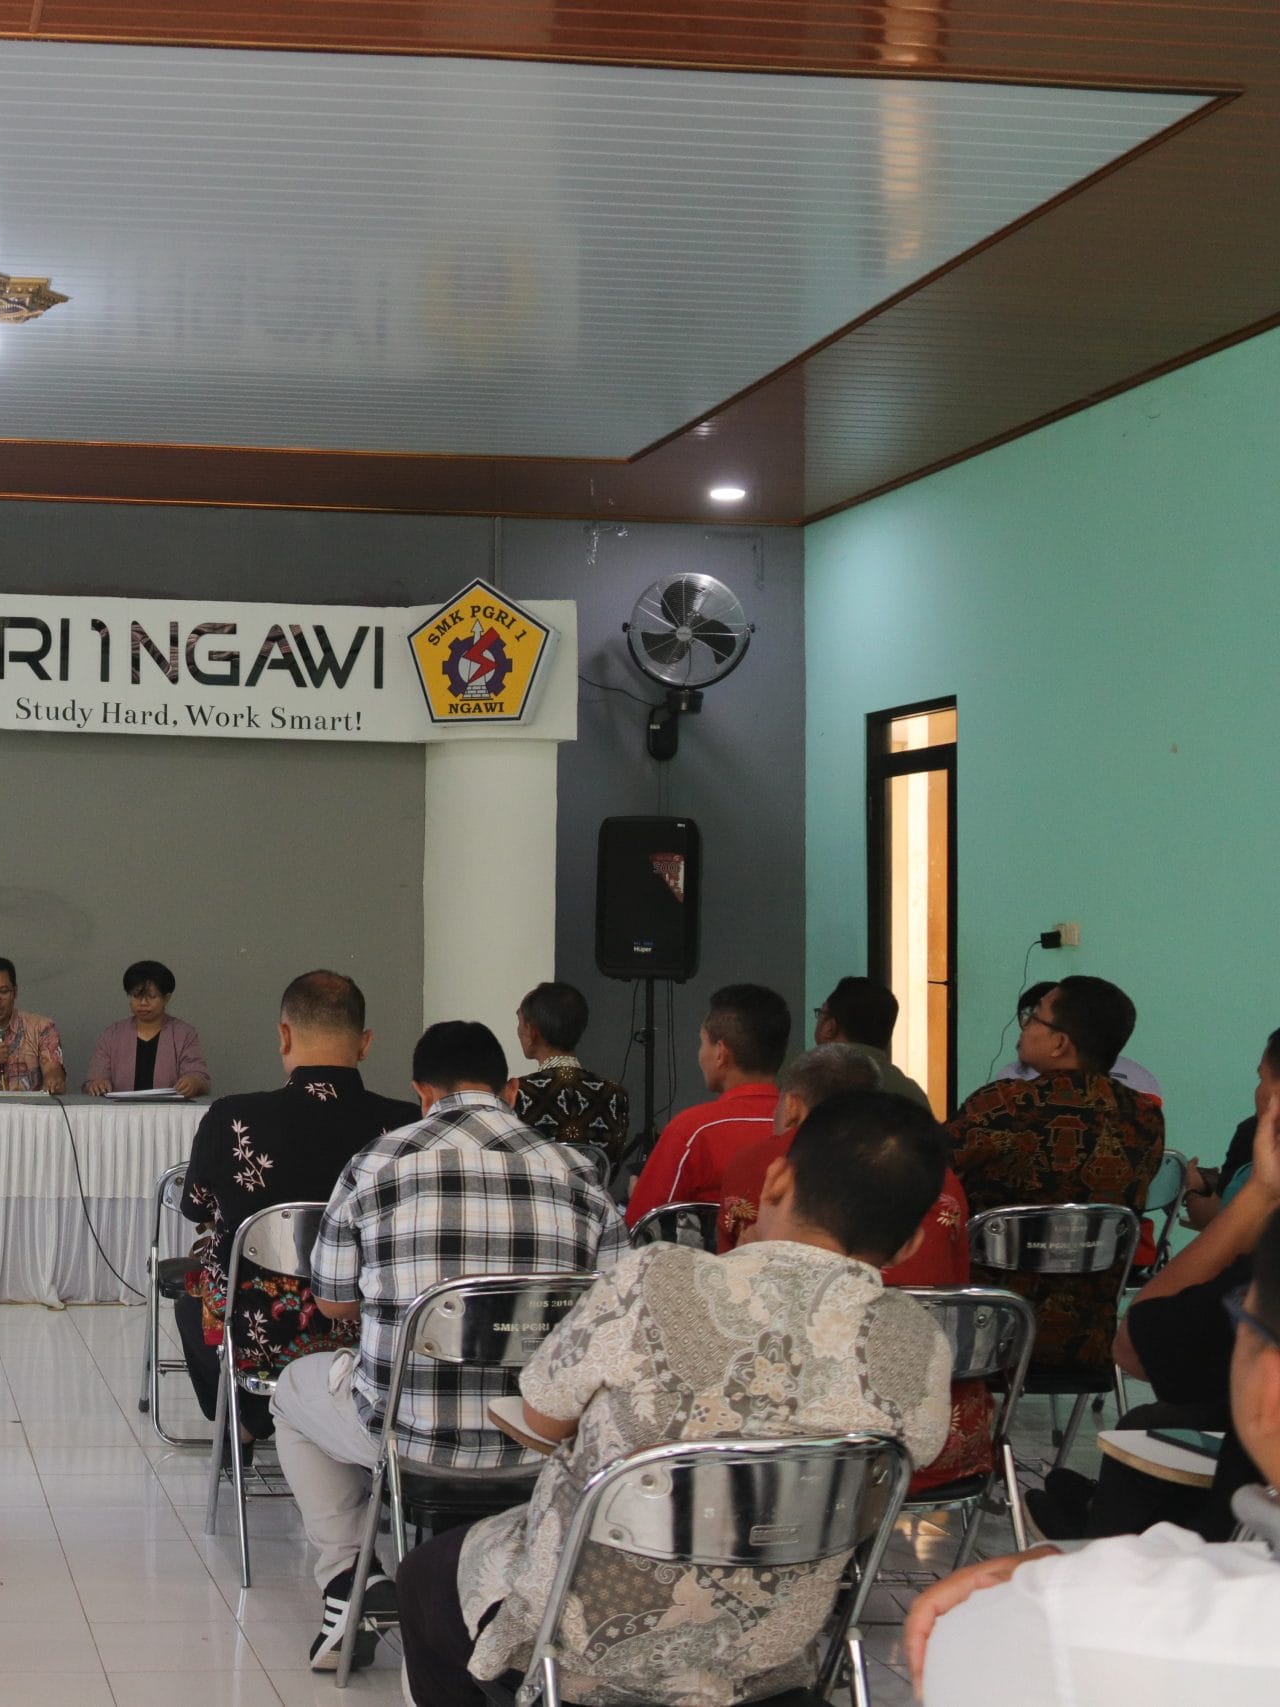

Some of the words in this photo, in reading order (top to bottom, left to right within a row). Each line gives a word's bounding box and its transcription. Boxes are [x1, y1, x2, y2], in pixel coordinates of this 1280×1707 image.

[427, 609, 465, 647] SMK
[470, 605, 517, 630] PGRI
[514, 629, 528, 643] 1
[90, 616, 112, 683] 1
[130, 619, 384, 690] NGAWI
[14, 696, 93, 729] Study
[101, 702, 178, 729] Hard,
[185, 704, 262, 730] Work
[269, 707, 363, 732] Smart!
[448, 701, 505, 714] NGAWI
[492, 1322, 519, 1332] SMK
